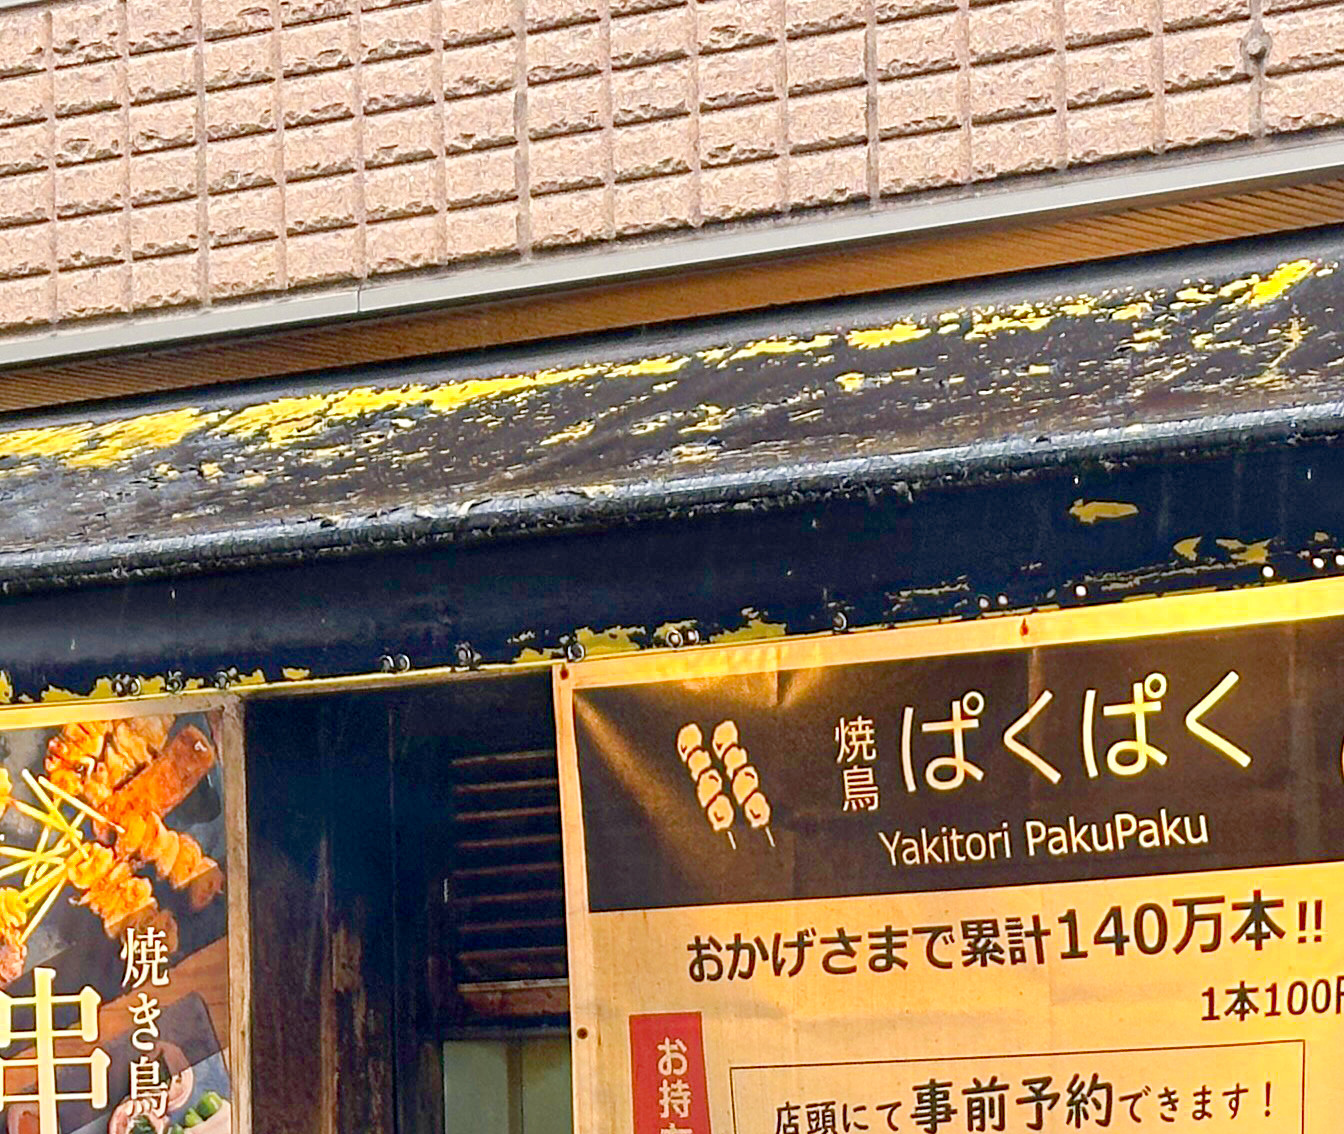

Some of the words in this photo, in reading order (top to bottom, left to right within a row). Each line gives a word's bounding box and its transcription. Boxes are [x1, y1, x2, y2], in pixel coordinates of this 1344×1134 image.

[834, 715, 881, 812] 焼鳥
[900, 668, 1254, 795] ぱくぱく
[878, 822, 1014, 870] Yakitori
[1026, 807, 1210, 859] PakuPaku
[120, 926, 171, 1118] 焼き鳥
